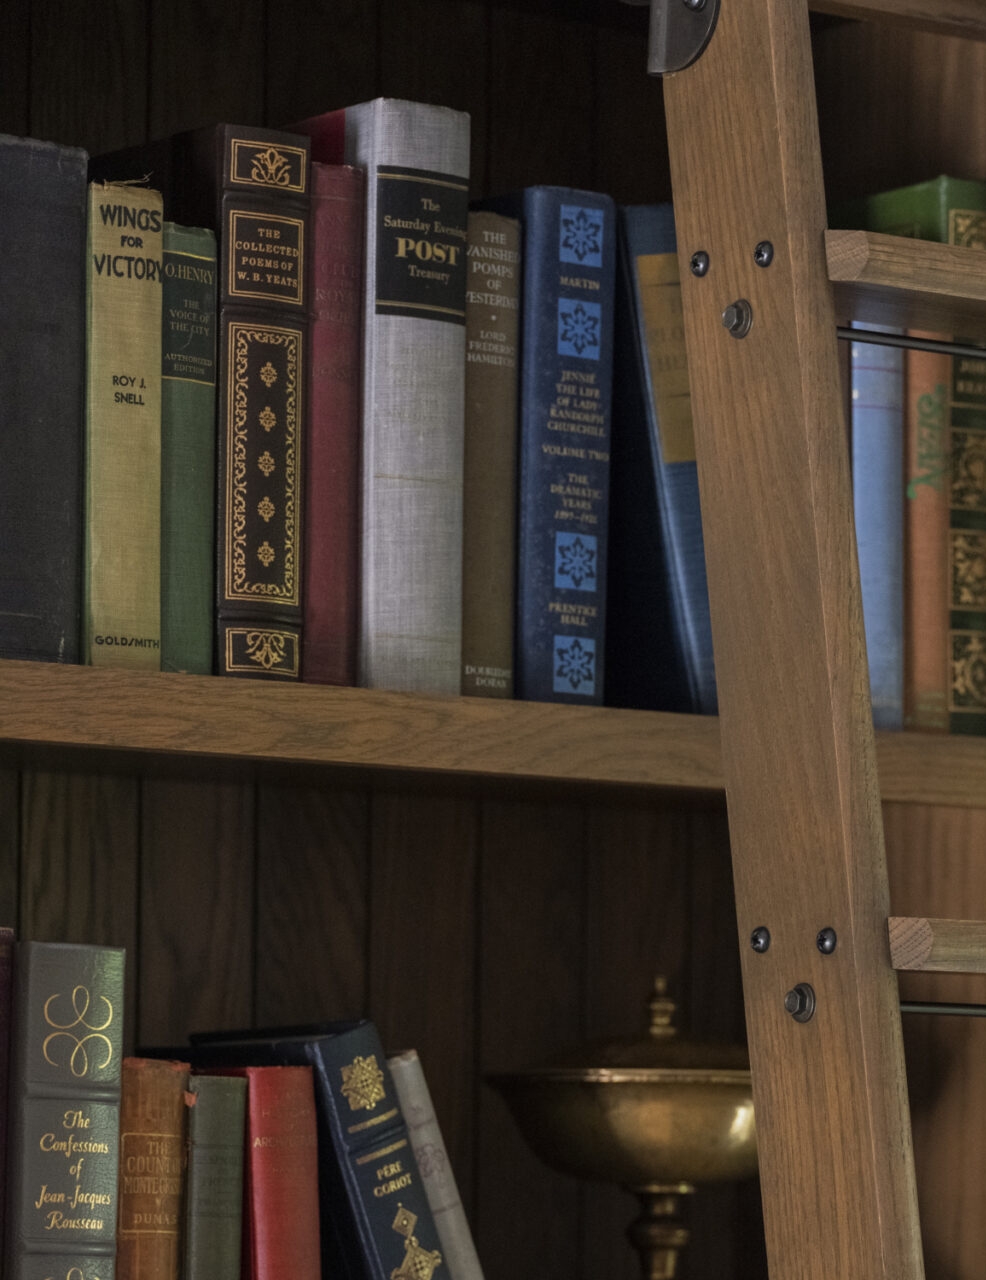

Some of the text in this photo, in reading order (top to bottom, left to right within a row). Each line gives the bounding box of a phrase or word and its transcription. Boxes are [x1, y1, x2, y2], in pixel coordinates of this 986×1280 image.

[420, 197, 441, 212] The
[100, 203, 162, 232] WINGS
[383, 215, 431, 235] Saturday
[258, 227, 281, 239] THE
[482, 231, 507, 245] THE
[121, 235, 143, 248] FOR
[235, 240, 299, 259] COLLECTED
[394, 236, 460, 266] POST
[241, 256, 294, 272] POEMS OF
[472, 261, 514, 279] POMPS
[237, 270, 299, 289] W. B. YEATS
[408, 264, 451, 285] Treasury
[486, 279, 502, 291] OF
[559, 276, 600, 290] MARTIN
[184, 298, 200, 311] THE
[169, 309, 198, 322] VOICE
[170, 321, 189, 333] THE
[480, 330, 507, 342] LORD
[112, 374, 147, 389] ROY J.
[556, 383, 577, 396] THE
[114, 392, 145, 406] SNELL
[541, 444, 586, 459] VOLUME
[95, 634, 160, 649] GOLDSMITH
[63, 1110, 90, 1129] The
[40, 1133, 109, 1158] Confessions
[70, 1158, 85, 1181] of
[45, 1210, 104, 1230] Rousseau
[134, 1212, 177, 1225] DUMAS
